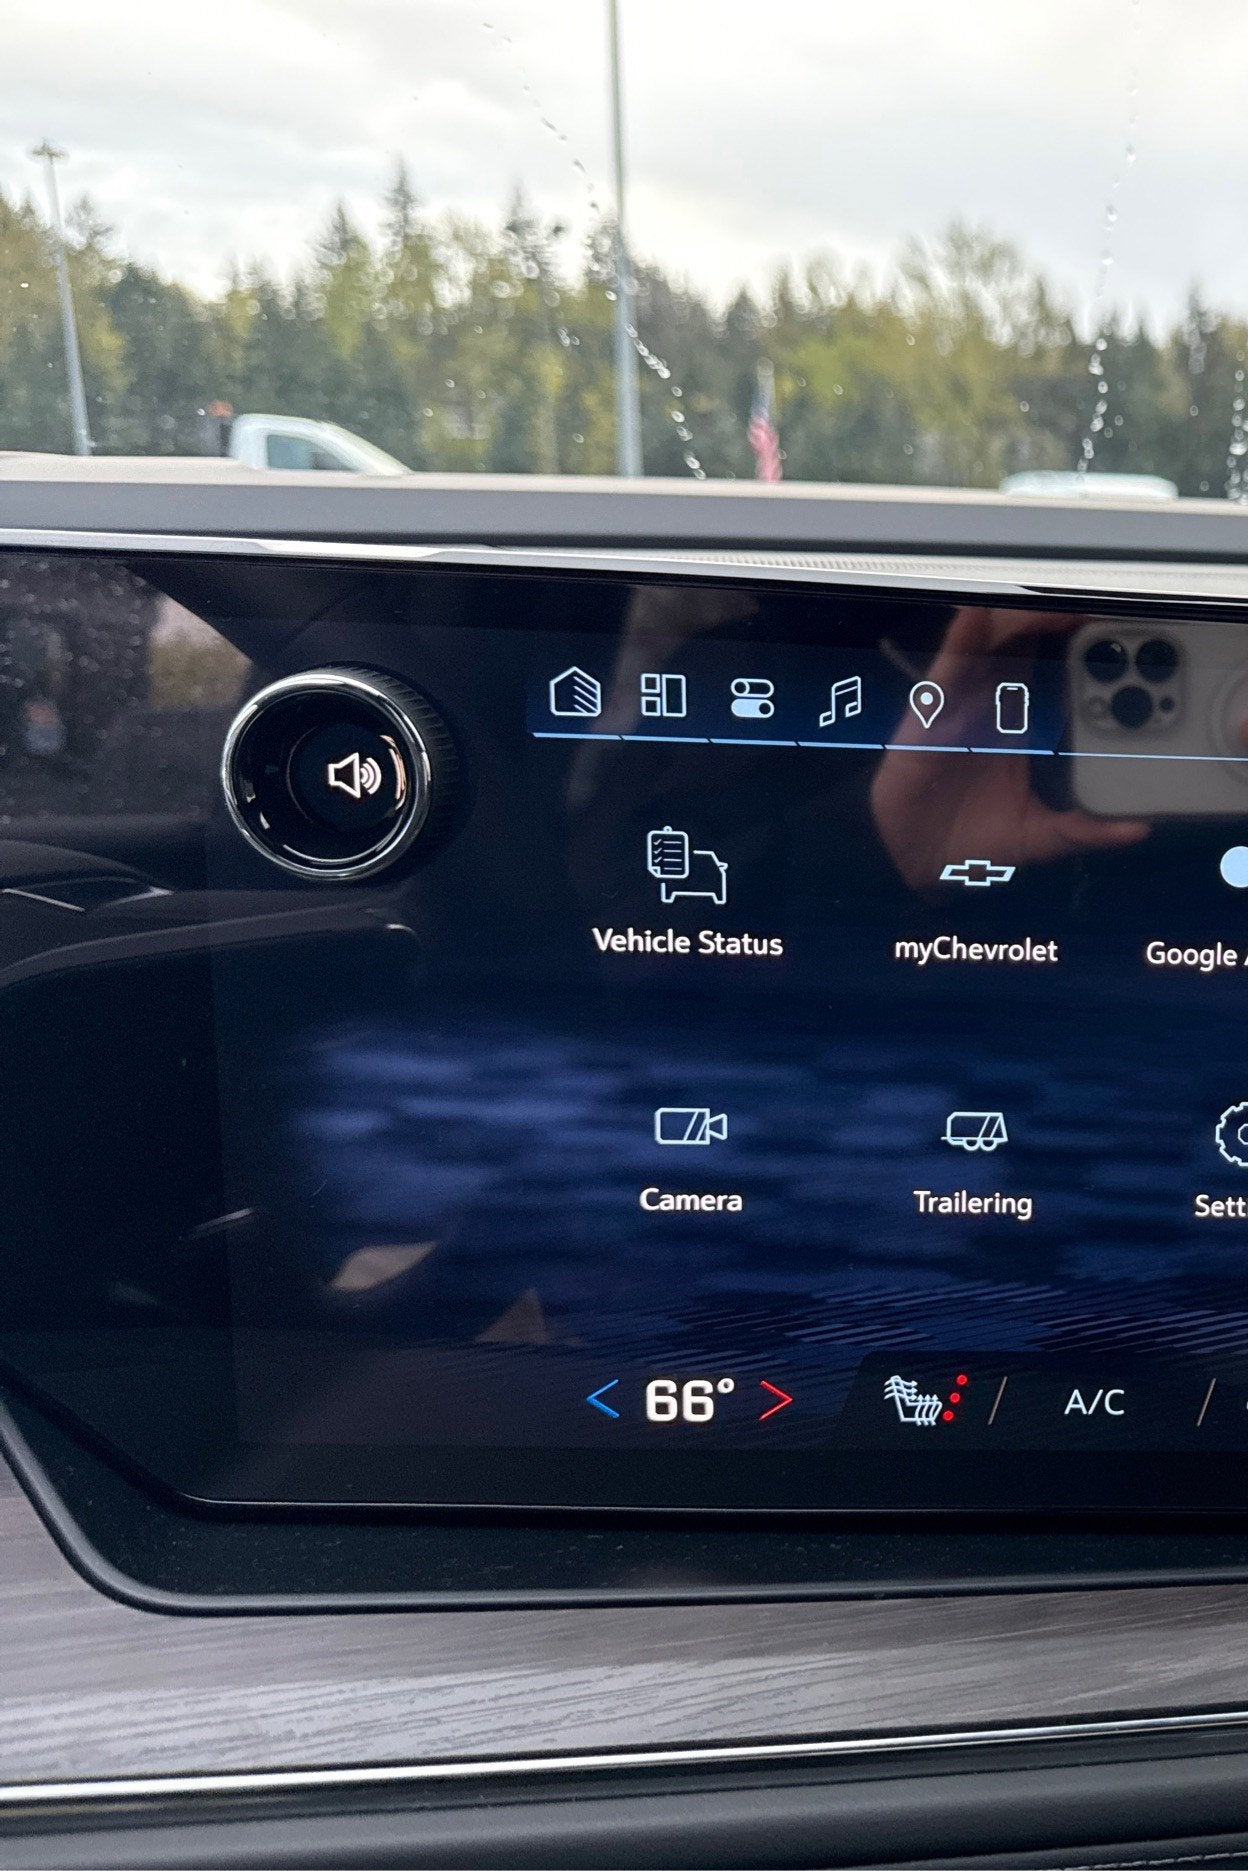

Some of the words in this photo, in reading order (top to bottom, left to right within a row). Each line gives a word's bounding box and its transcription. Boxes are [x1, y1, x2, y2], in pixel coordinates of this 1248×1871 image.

[591, 927, 691, 954] Vehicle
[698, 930, 784, 956] Status
[895, 935, 1059, 966] myChevrolet
[1146, 941, 1238, 972] Google
[639, 1187, 743, 1212] Camera
[912, 1189, 1033, 1221] Trailering
[645, 1377, 735, 1422] 66°
[1064, 1388, 1125, 1416] A/C
